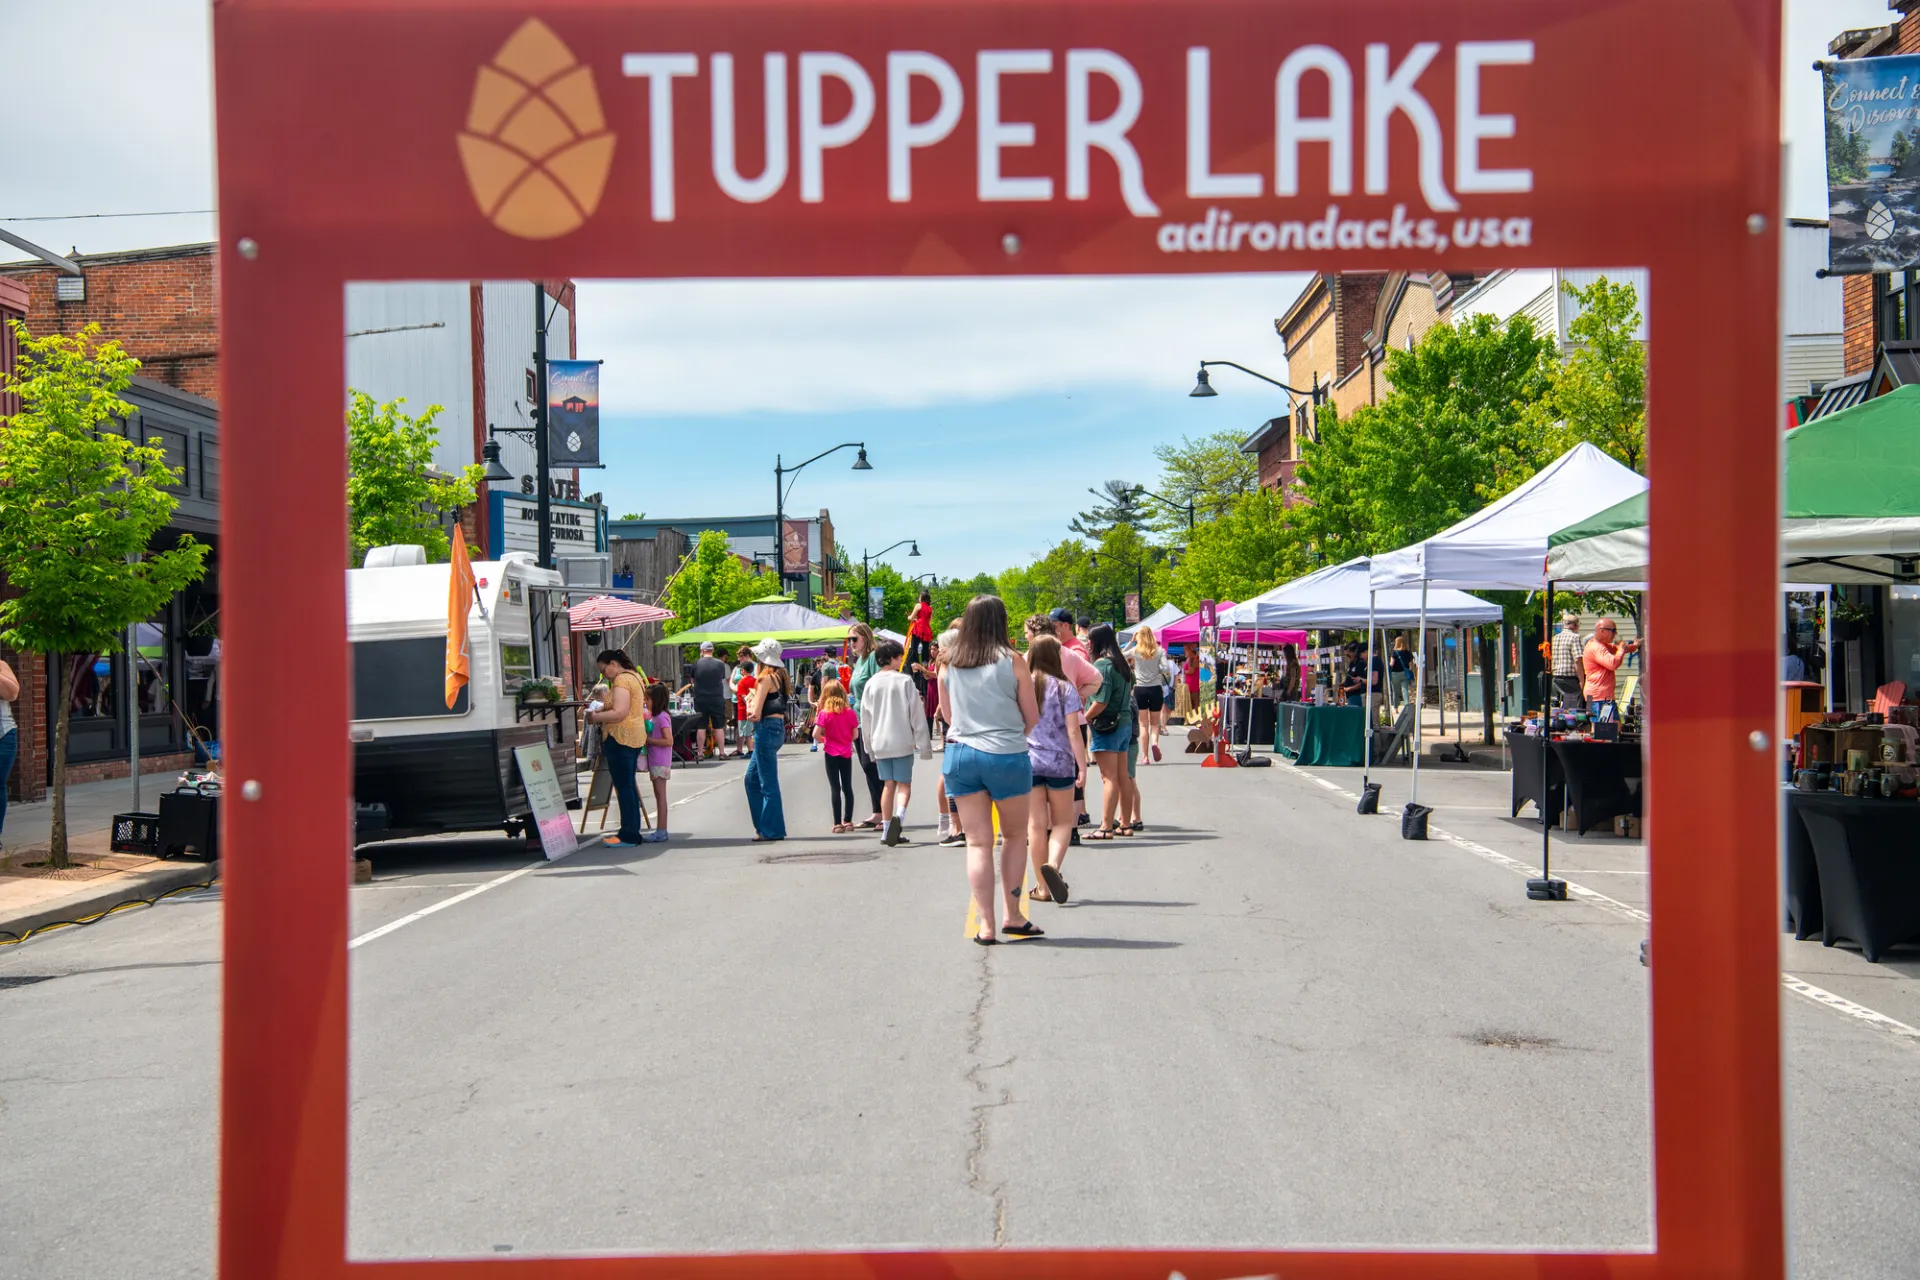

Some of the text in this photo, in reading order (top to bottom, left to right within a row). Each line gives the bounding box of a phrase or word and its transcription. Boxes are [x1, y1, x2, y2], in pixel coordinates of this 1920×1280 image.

[1828, 76, 1909, 111] Connect
[622, 40, 1535, 222] TUPPER LAKE
[520, 474, 579, 501] SATE
[550, 512, 581, 526] LAYING
[550, 527, 584, 541] FURIOSA
